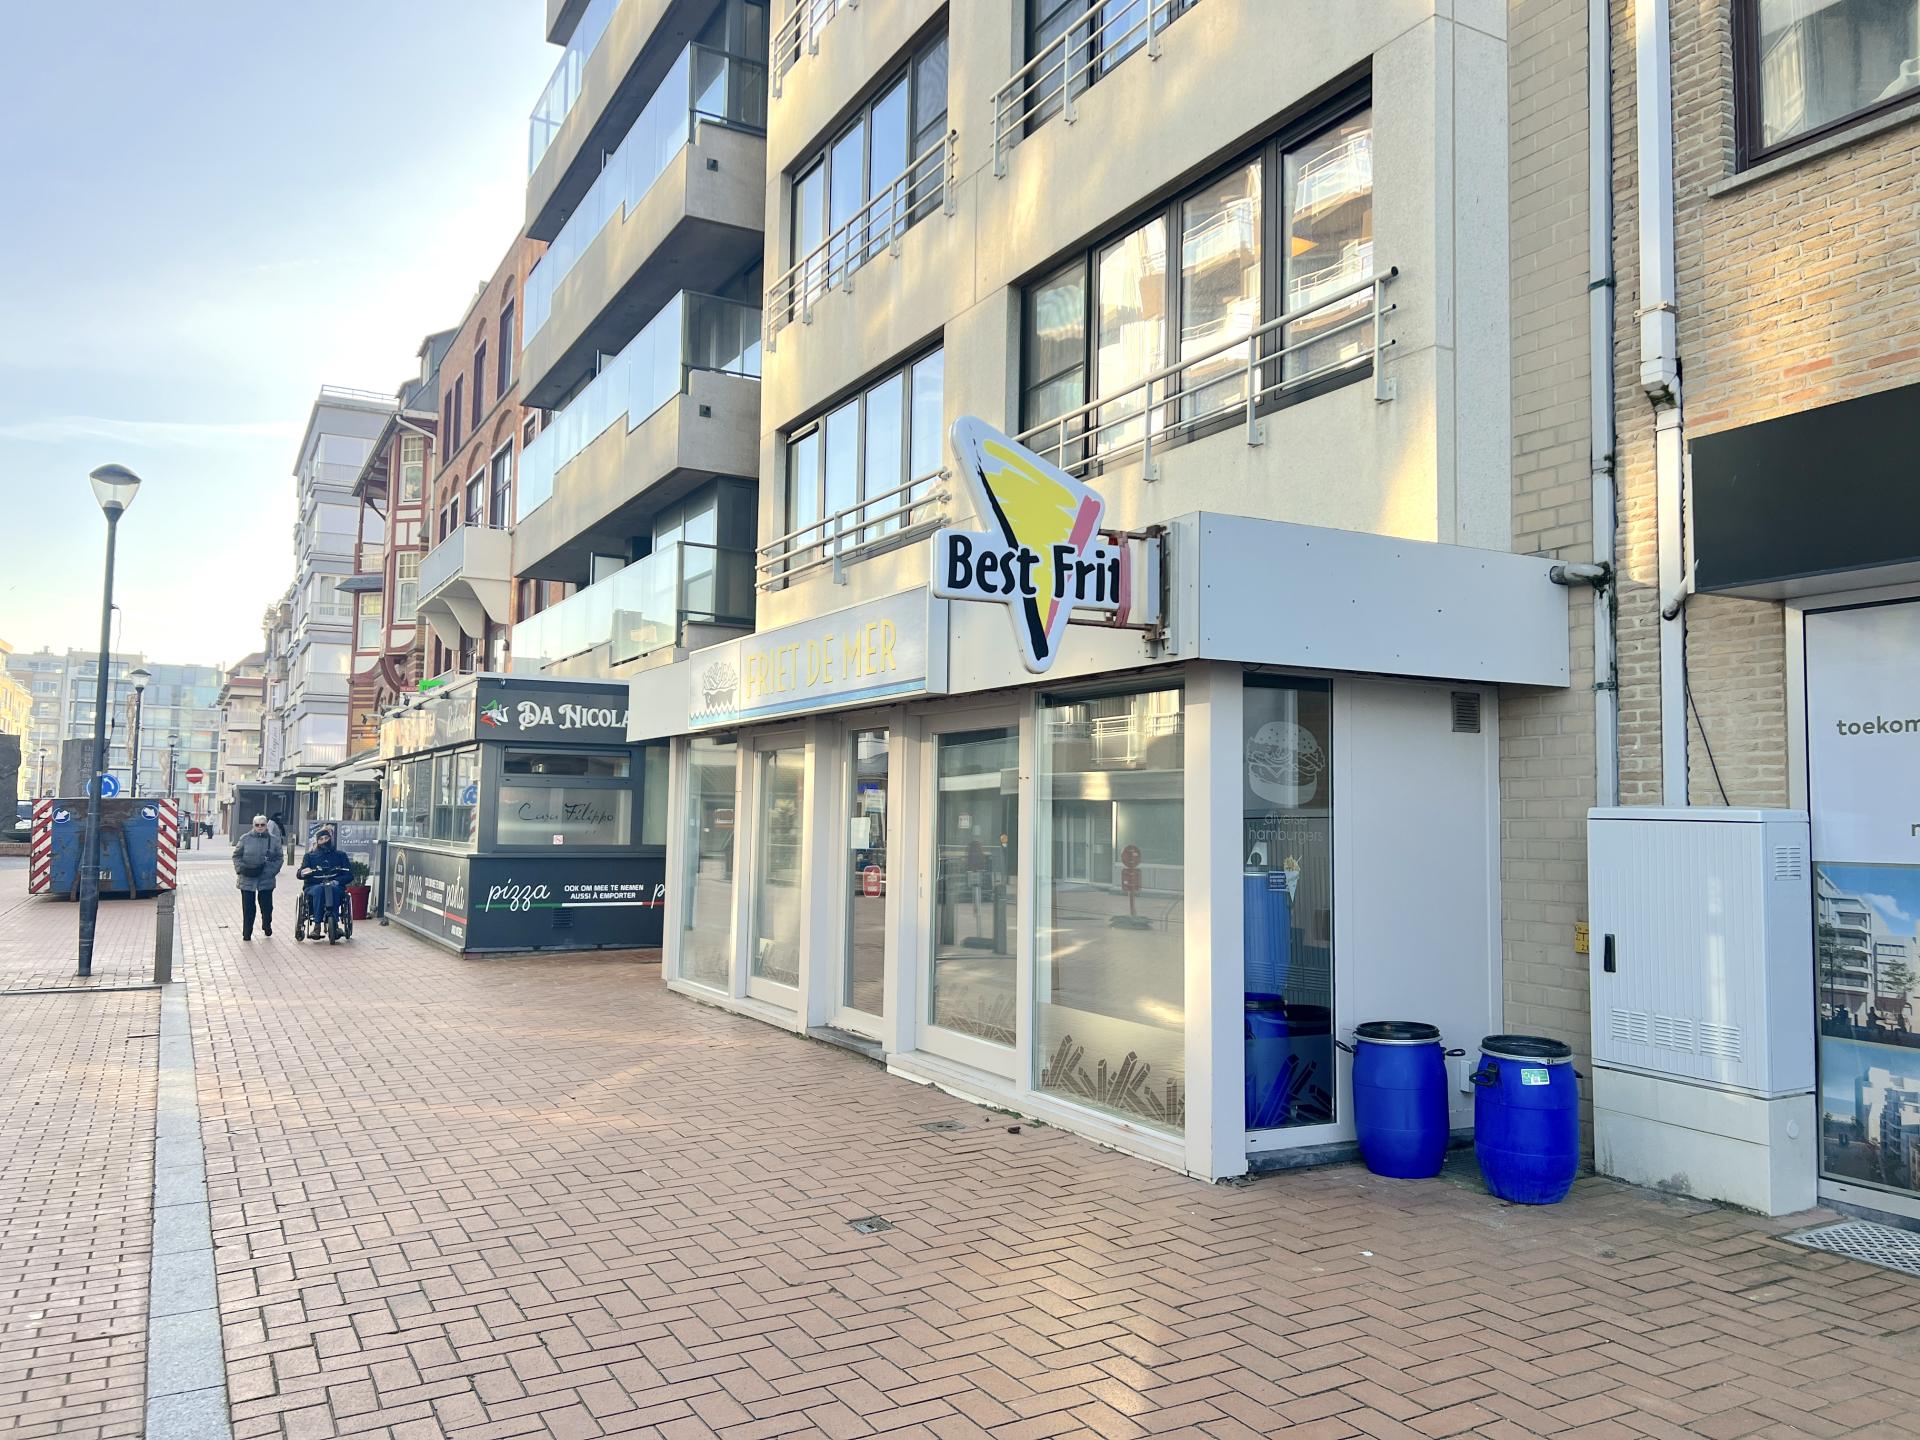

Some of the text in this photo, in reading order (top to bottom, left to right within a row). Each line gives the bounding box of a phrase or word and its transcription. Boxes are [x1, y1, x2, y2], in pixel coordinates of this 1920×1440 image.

[947, 534, 1120, 604] Best Frit
[746, 618, 897, 699] FRIET DE MER
[564, 802, 614, 825] Filippo
[1264, 811, 1308, 826] diverse
[1248, 827, 1325, 845] hamburgers
[443, 865, 465, 926] pasta
[485, 878, 551, 913] pizza
[564, 885, 579, 893] OOK
[611, 884, 619, 892] TE
[620, 884, 644, 892] NEMEN
